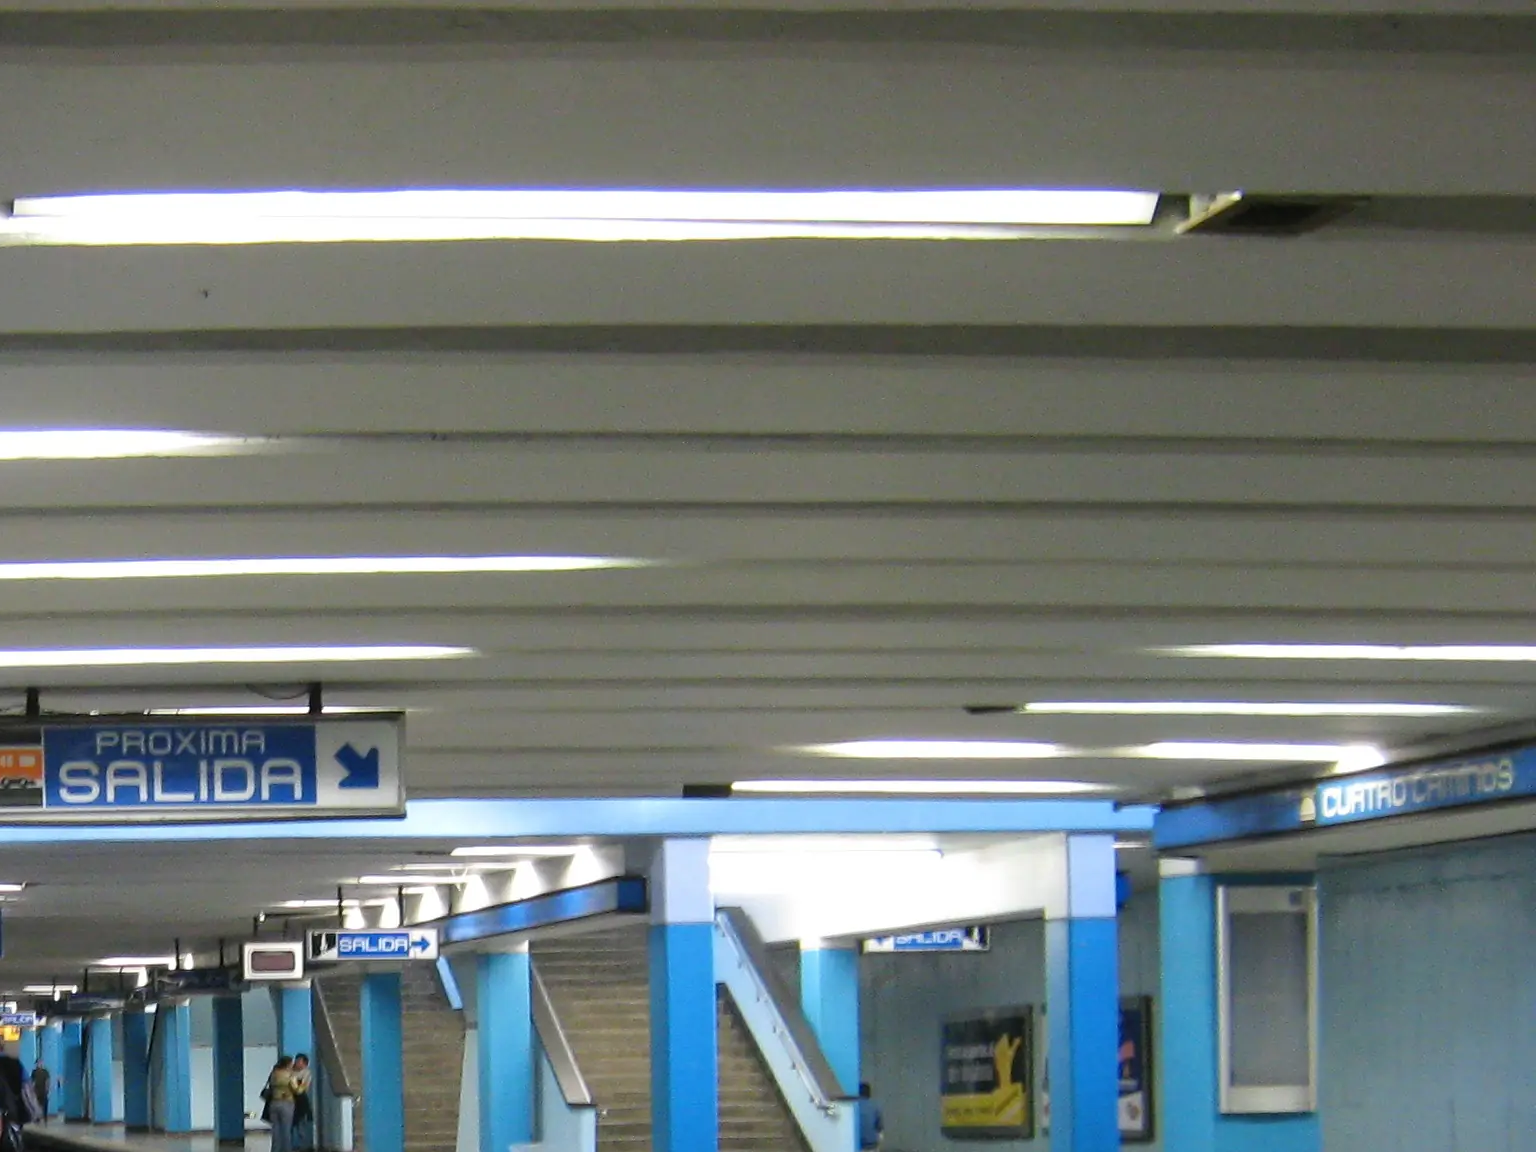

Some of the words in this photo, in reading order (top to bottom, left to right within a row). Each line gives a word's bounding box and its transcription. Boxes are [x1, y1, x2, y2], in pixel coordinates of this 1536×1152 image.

[95, 729, 265, 756] PROXIMA
[58, 758, 304, 803] SALIDA
[1321, 775, 1407, 818] CUATRO
[339, 936, 408, 953] SALIDA
